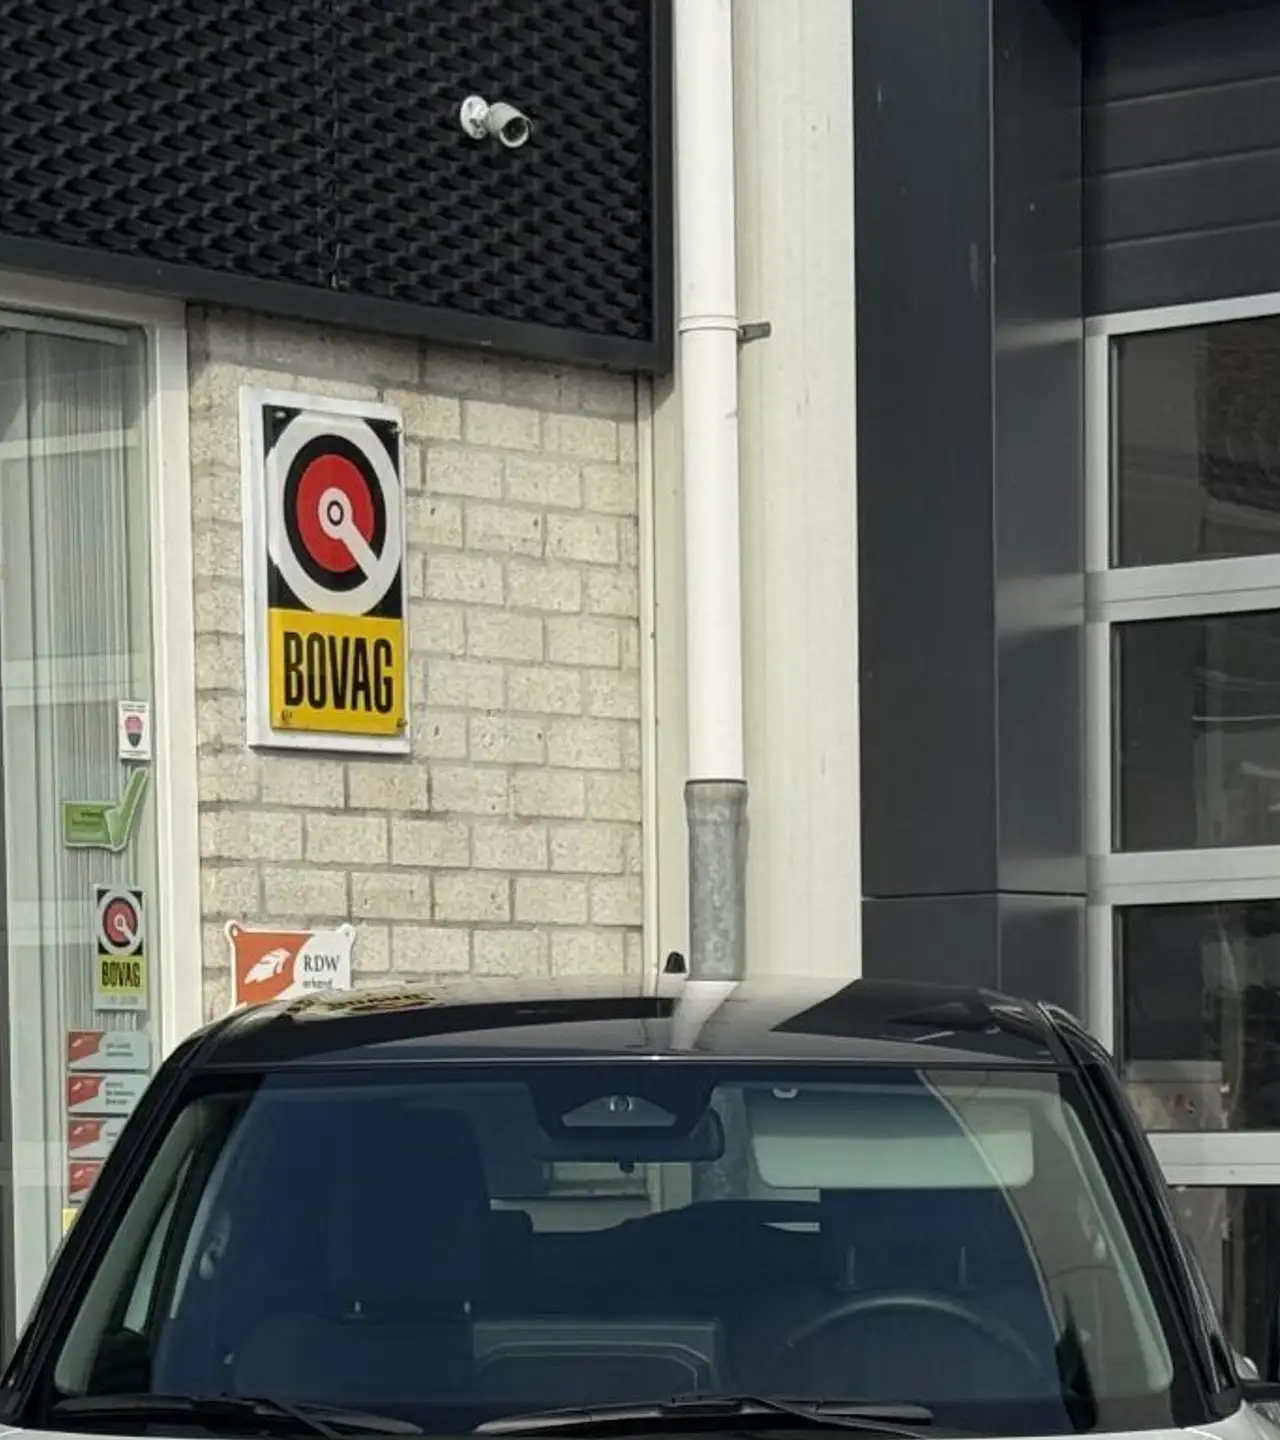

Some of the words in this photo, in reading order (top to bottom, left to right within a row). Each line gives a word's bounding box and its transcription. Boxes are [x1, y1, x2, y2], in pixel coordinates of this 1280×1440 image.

[283, 630, 394, 715] BOVAG
[101, 961, 141, 988] BOVAG
[303, 953, 341, 973] RDW
